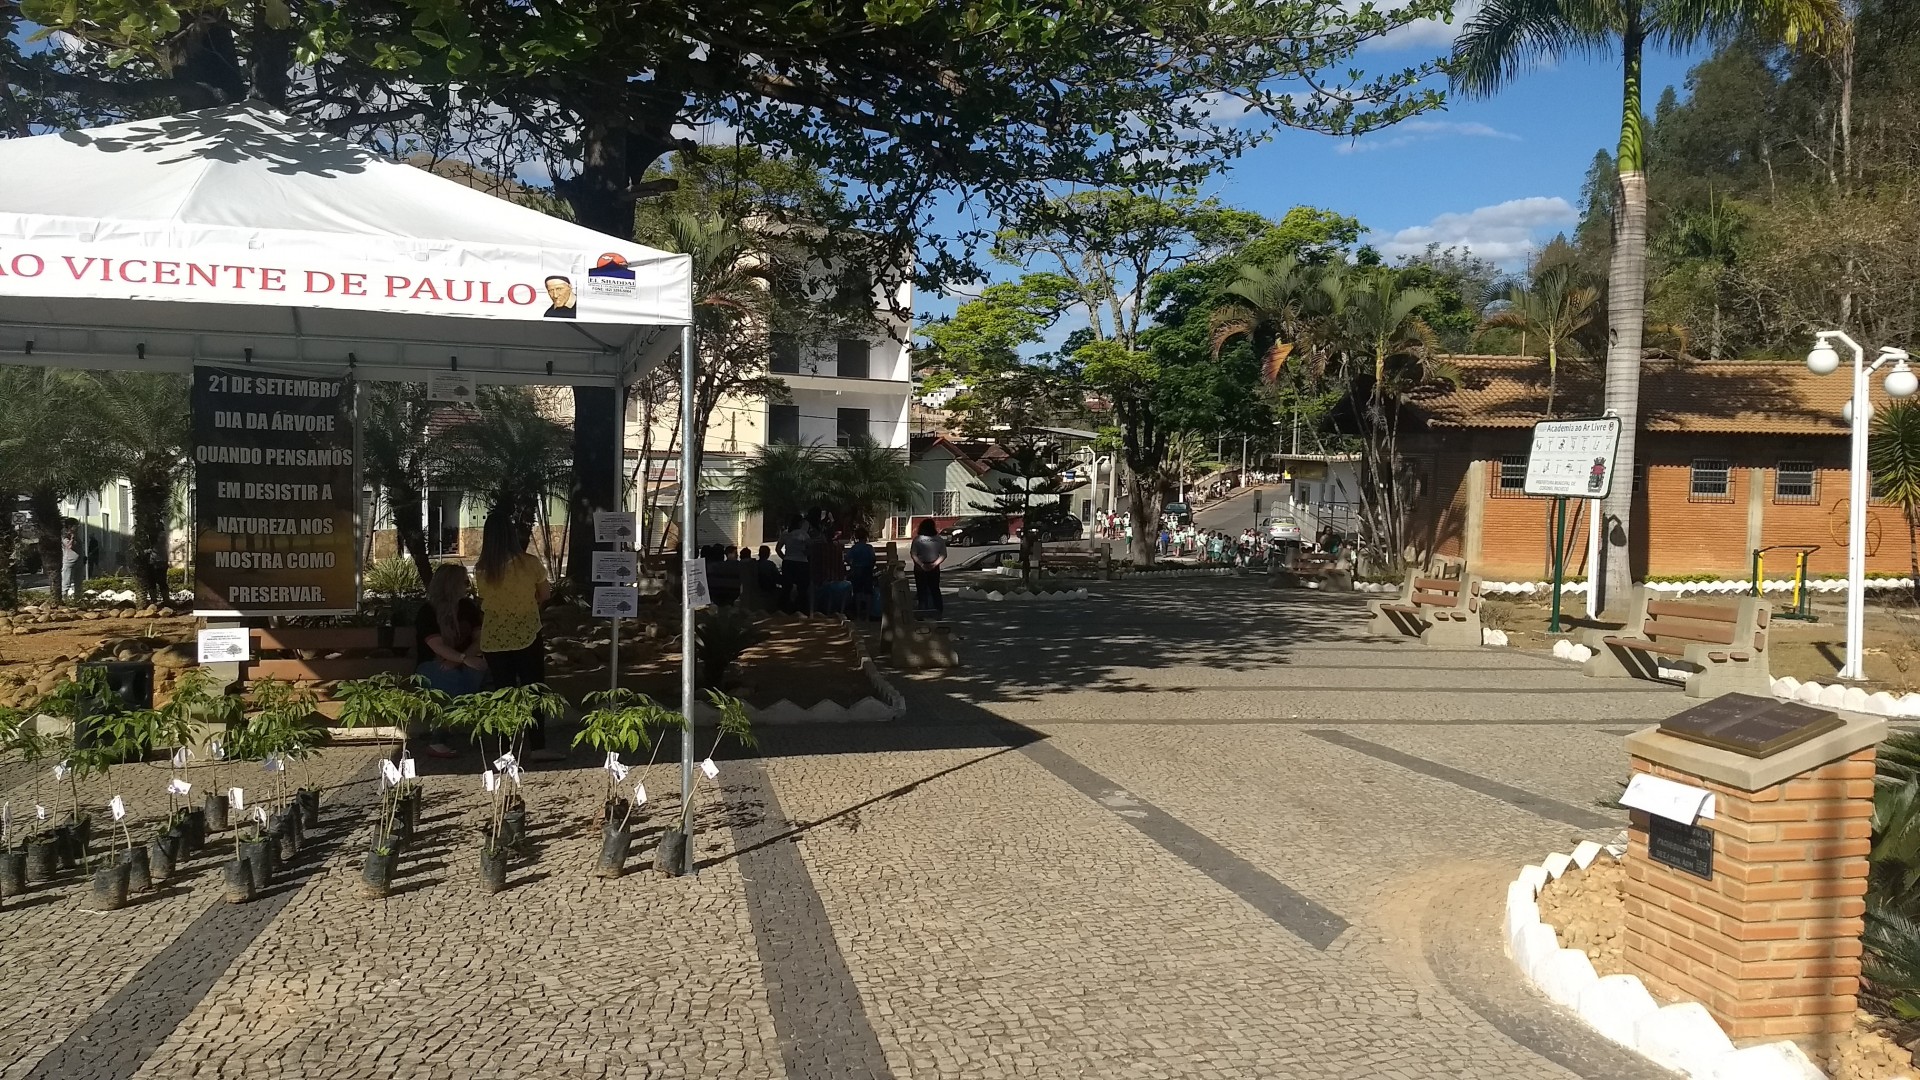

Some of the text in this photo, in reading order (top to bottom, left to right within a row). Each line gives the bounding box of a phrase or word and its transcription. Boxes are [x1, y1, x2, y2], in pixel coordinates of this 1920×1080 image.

[0, 247, 538, 306] O VICENTE DE PAULO
[209, 375, 341, 398] 21 DE SETEMBRO
[215, 410, 335, 432] DIA DA ÁRVORE
[1547, 424, 1574, 432] Academia
[1583, 423, 1590, 431] Ar
[1591, 423, 1606, 431] Livre
[196, 445, 353, 467] QUANDO PENSAMOS
[217, 481, 333, 501] EM DESISTIR A
[217, 517, 334, 535] NATUREZA NOS
[215, 551, 335, 569] MOSTRA COMO
[229, 586, 326, 603] PRESERVAR.
